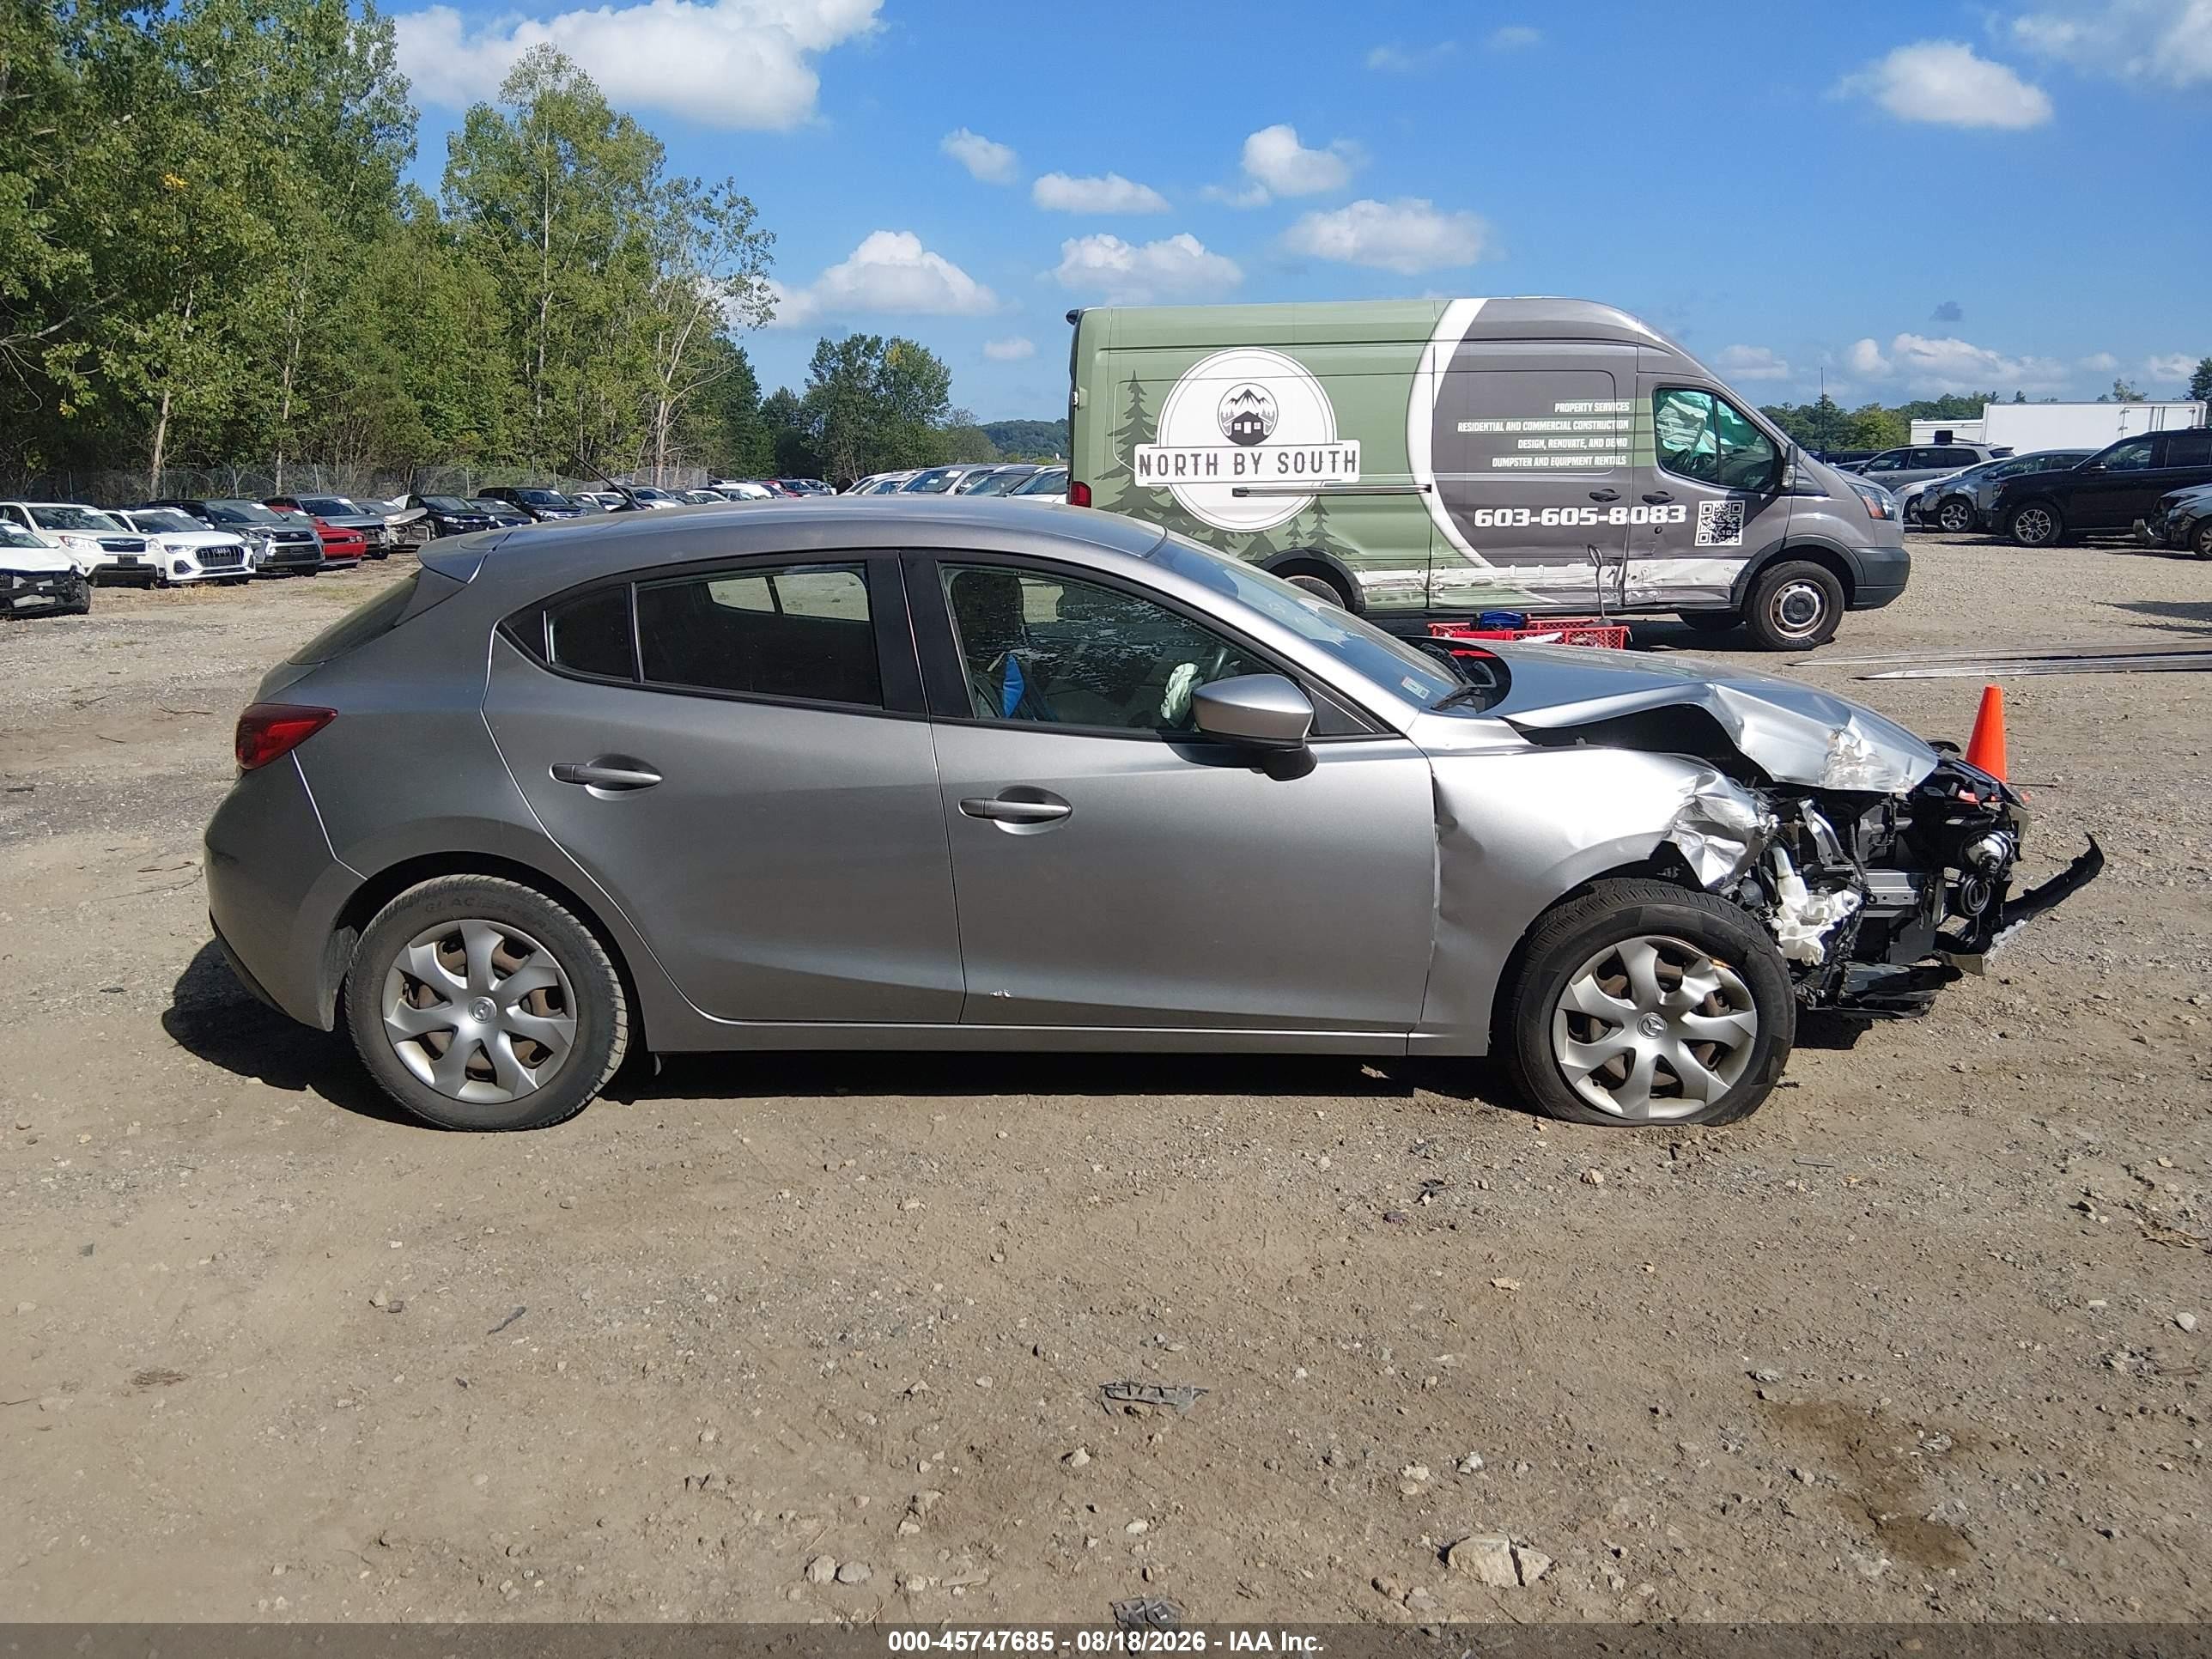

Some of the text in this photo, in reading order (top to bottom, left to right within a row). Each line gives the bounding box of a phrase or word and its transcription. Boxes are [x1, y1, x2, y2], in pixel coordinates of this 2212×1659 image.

[1554, 401, 1630, 413] PROPERTY SERVICES
[1457, 419, 1629, 432] RESIDENTIAL AND COMMERCIAL CONSTRUCTION
[1517, 437, 1628, 450] DESIGN, RENOVATE, AND DEMO
[1139, 450, 1357, 477] NORTH BY SOUTH
[1492, 455, 1626, 468] DUMPSTER AND EQUIPMENT RENTALS
[1474, 505, 1687, 527] 603-605-8083
